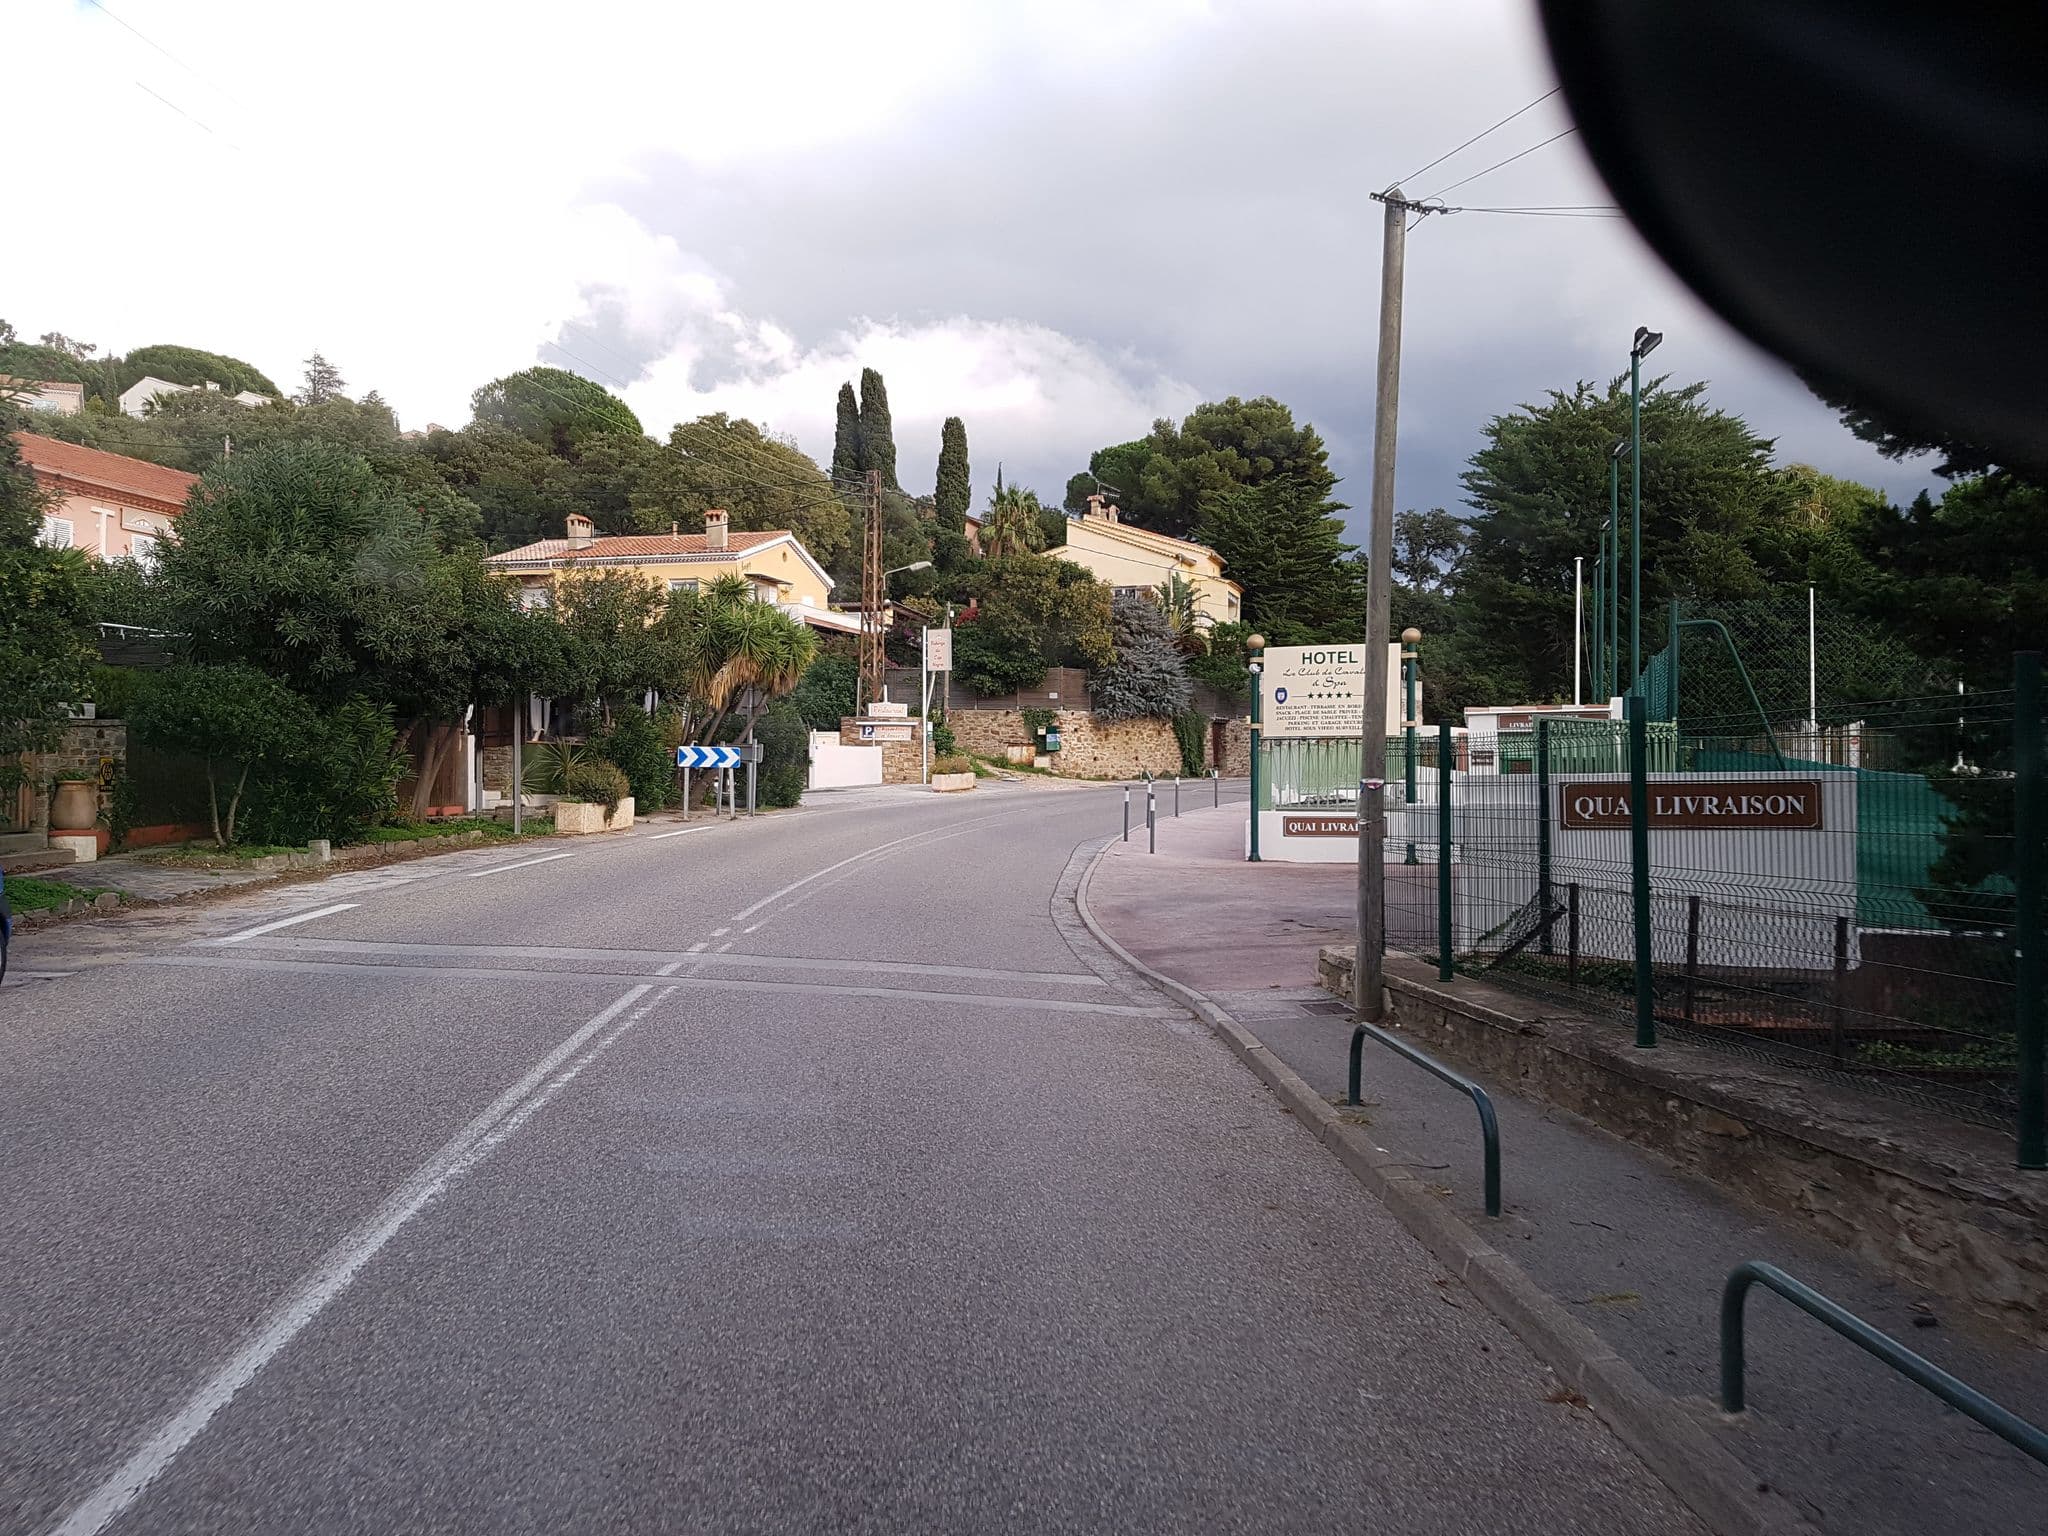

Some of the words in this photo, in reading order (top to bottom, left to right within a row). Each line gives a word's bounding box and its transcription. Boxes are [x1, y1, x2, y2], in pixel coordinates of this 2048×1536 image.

[1302, 651, 1358, 665] HOTEL
[1283, 668, 1295, 676] Le
[1298, 668, 1320, 676] Club
[1322, 668, 1332, 676] de
[1322, 676, 1347, 689] Spa
[1574, 796, 1632, 819] QUA
[1655, 795, 1806, 816] LIVRAISON
[1289, 822, 1316, 832] QUAI
[1321, 822, 1359, 832] LIVRAI
